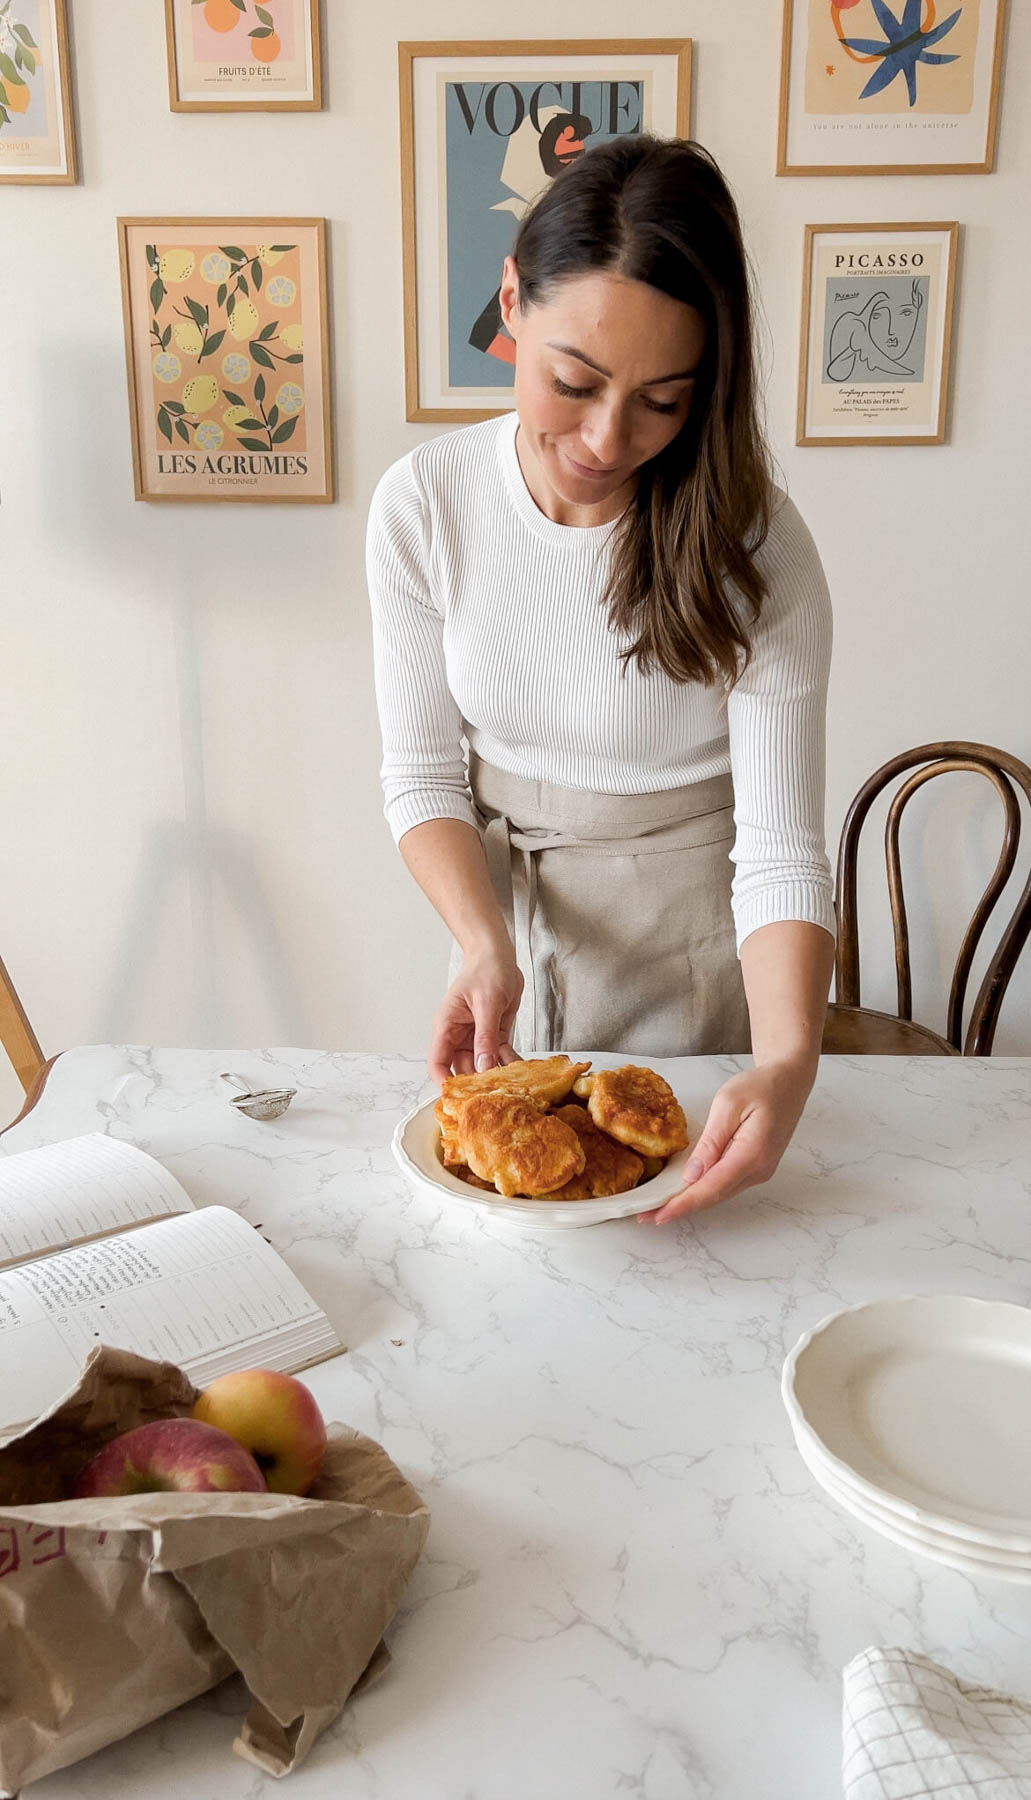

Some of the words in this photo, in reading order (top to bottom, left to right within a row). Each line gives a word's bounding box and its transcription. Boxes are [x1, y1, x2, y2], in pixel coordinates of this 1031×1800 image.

[218, 67, 247, 76] FRUITS
[249, 65, 272, 76] D'ÉTÉ
[452, 81, 641, 137] VOGUE
[866, 122, 889, 130] alone
[905, 121, 918, 129] the
[834, 253, 924, 268] PICASSO
[157, 454, 197, 474] LES
[201, 455, 308, 475] AGRUMES
[208, 477, 217, 485] LE
[218, 477, 258, 485] CITRONNIER
